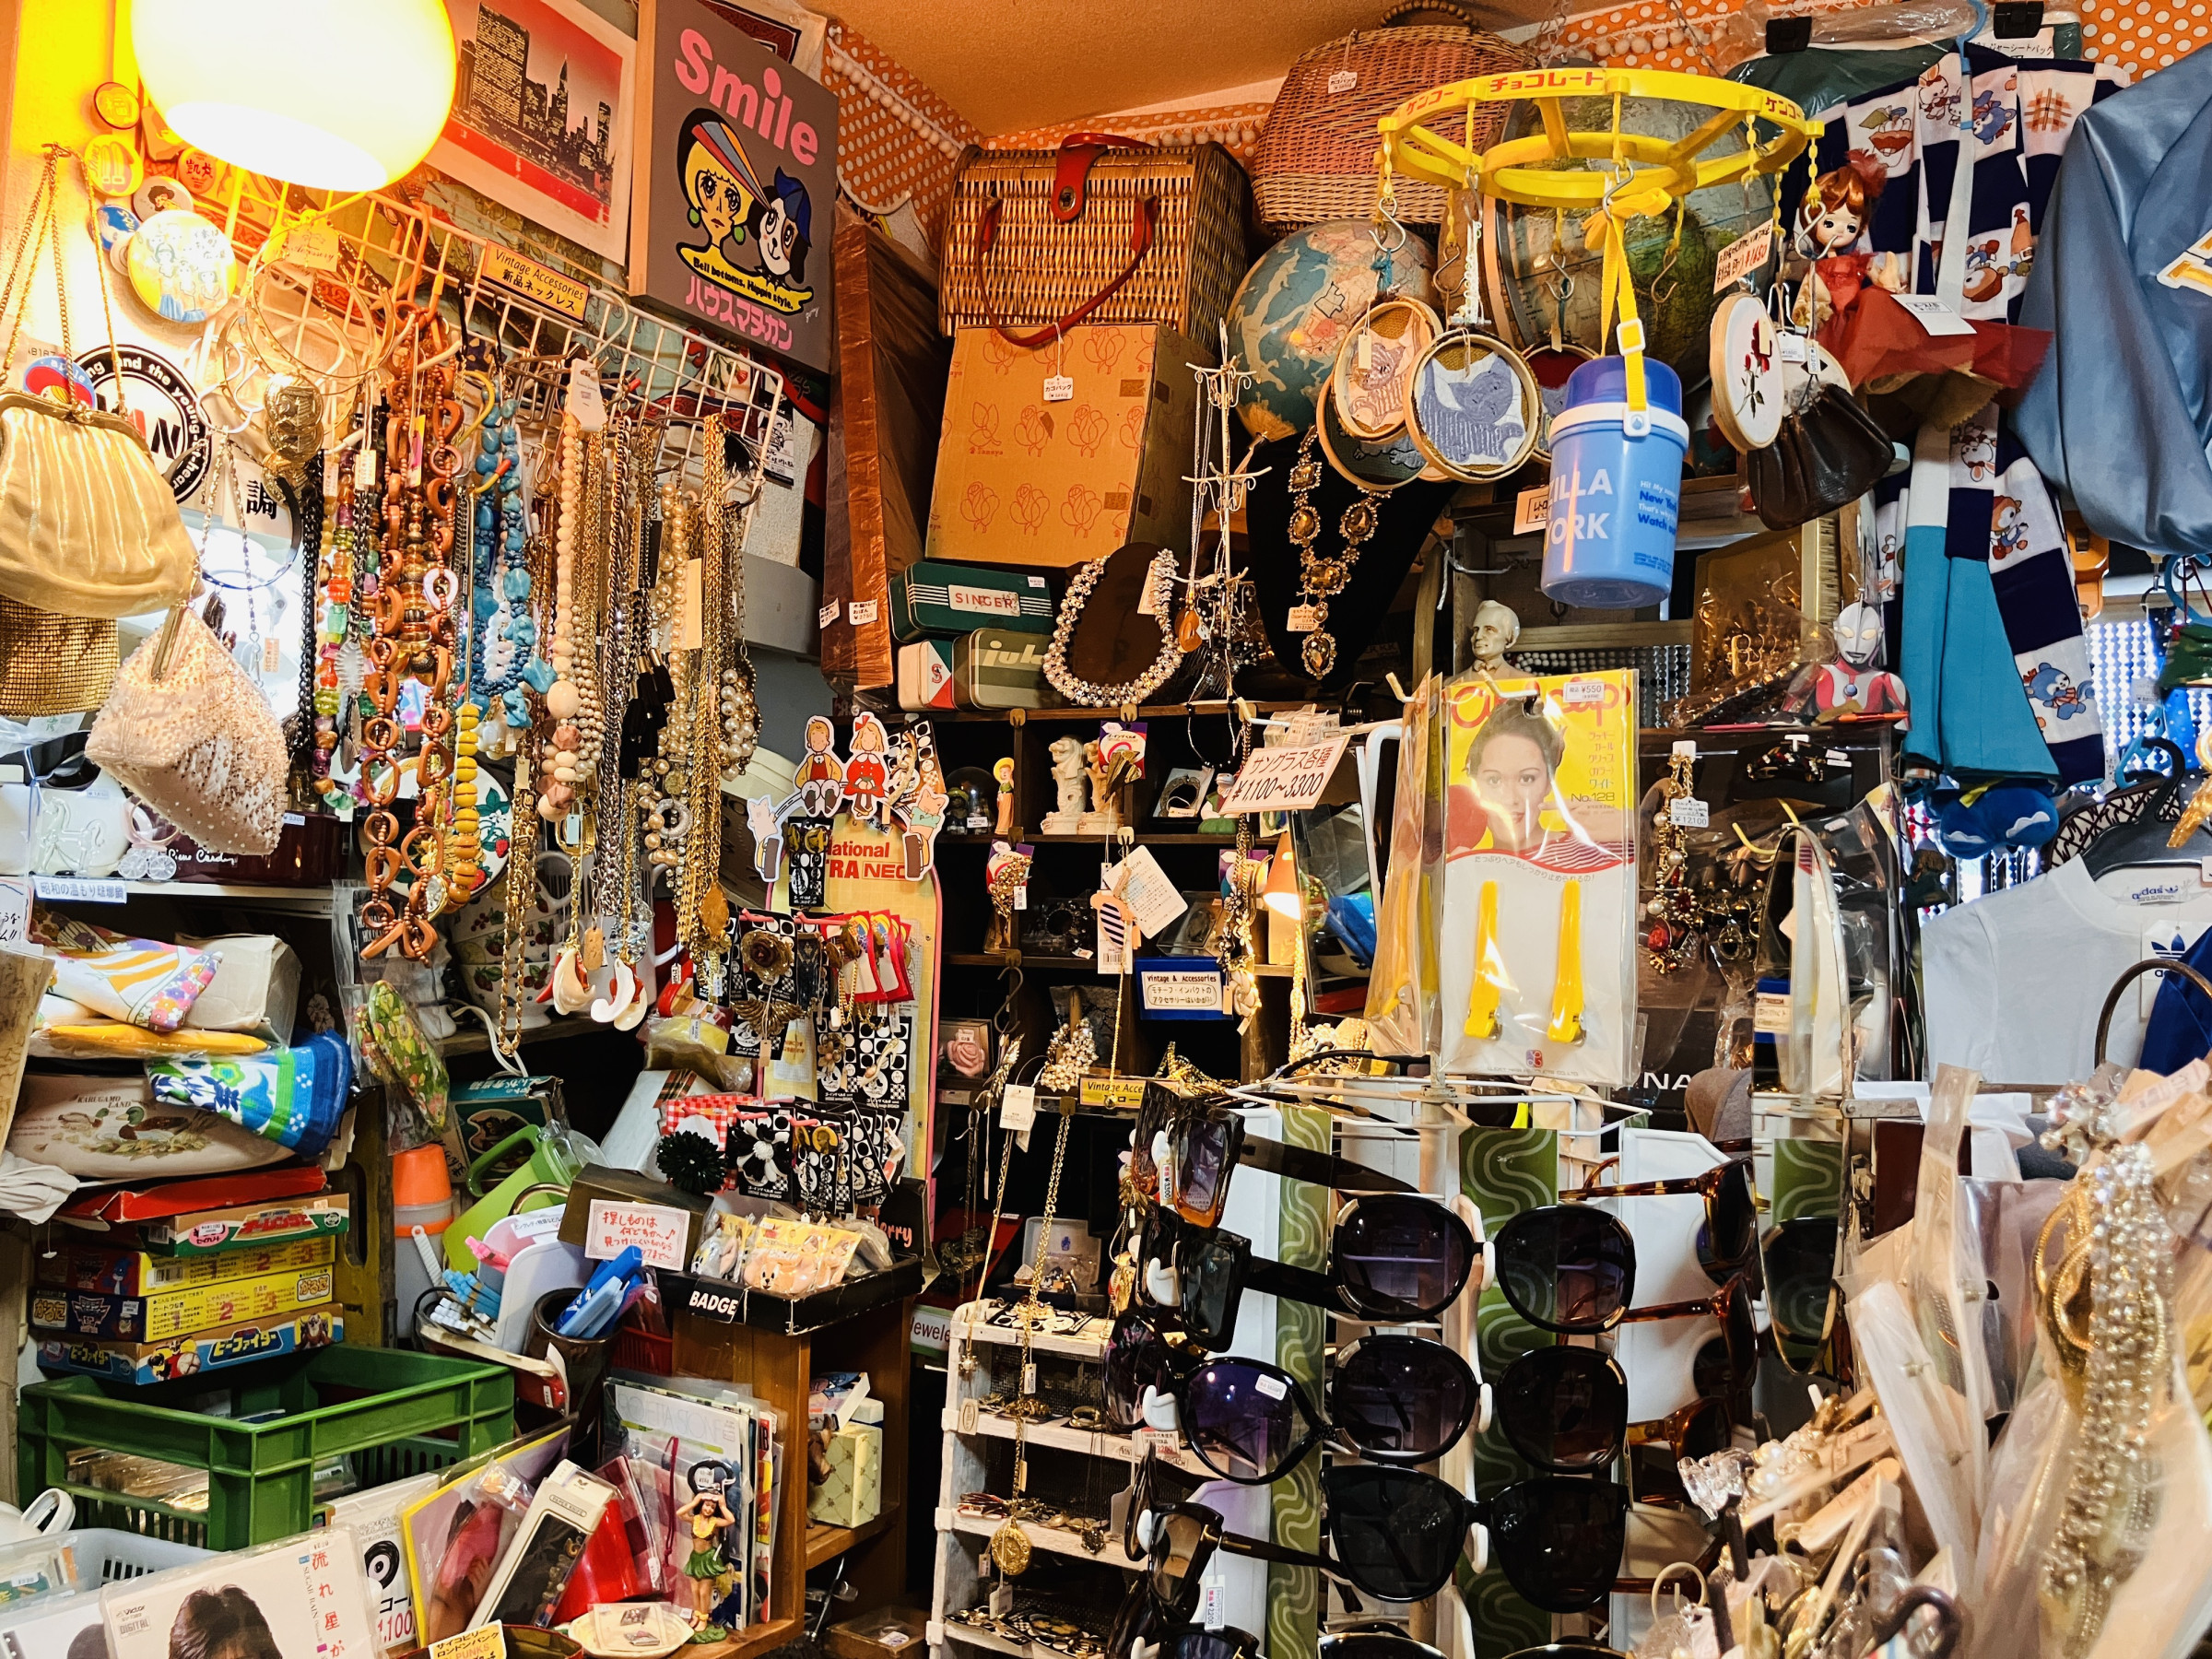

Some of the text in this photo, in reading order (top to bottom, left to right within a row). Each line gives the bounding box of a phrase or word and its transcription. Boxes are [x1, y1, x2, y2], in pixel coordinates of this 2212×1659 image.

[1489, 71, 1604, 92] チョコレート
[674, 28, 818, 166] Smile
[1406, 89, 1454, 116] ケンコー
[495, 248, 584, 300] Vintage Accessories
[692, 256, 711, 274] Bell
[502, 268, 575, 312] 新品ネックレス
[685, 275, 793, 351] ハウスマヌカン
[147, 362, 172, 386] the
[1639, 490, 1665, 505] New
[1637, 512, 1667, 529] Watch
[954, 592, 1014, 610] SINGER
[1582, 685, 1602, 693] ¥550
[1248, 746, 1335, 775] サングラス各種
[1571, 792, 1616, 803] No.128
[1147, 974, 1170, 982] Vintage
[1182, 974, 1217, 982] Accessories
[76, 1094, 122, 1104] KARUGAMO
[107, 1100, 132, 1109] LAND
[602, 1211, 658, 1229] 探しものは
[34, 1300, 66, 1323] かるた
[689, 1290, 739, 1316] BADGE
[214, 1331, 277, 1357] ビーファイター
[553, 1496, 583, 1516] PAPER KNIFE
[302, 1566, 313, 1594] SUGAR
[309, 1597, 319, 1619] RAIN
[120, 1617, 150, 1636] DIGITAL
[435, 1629, 488, 1651] サイコビリー
